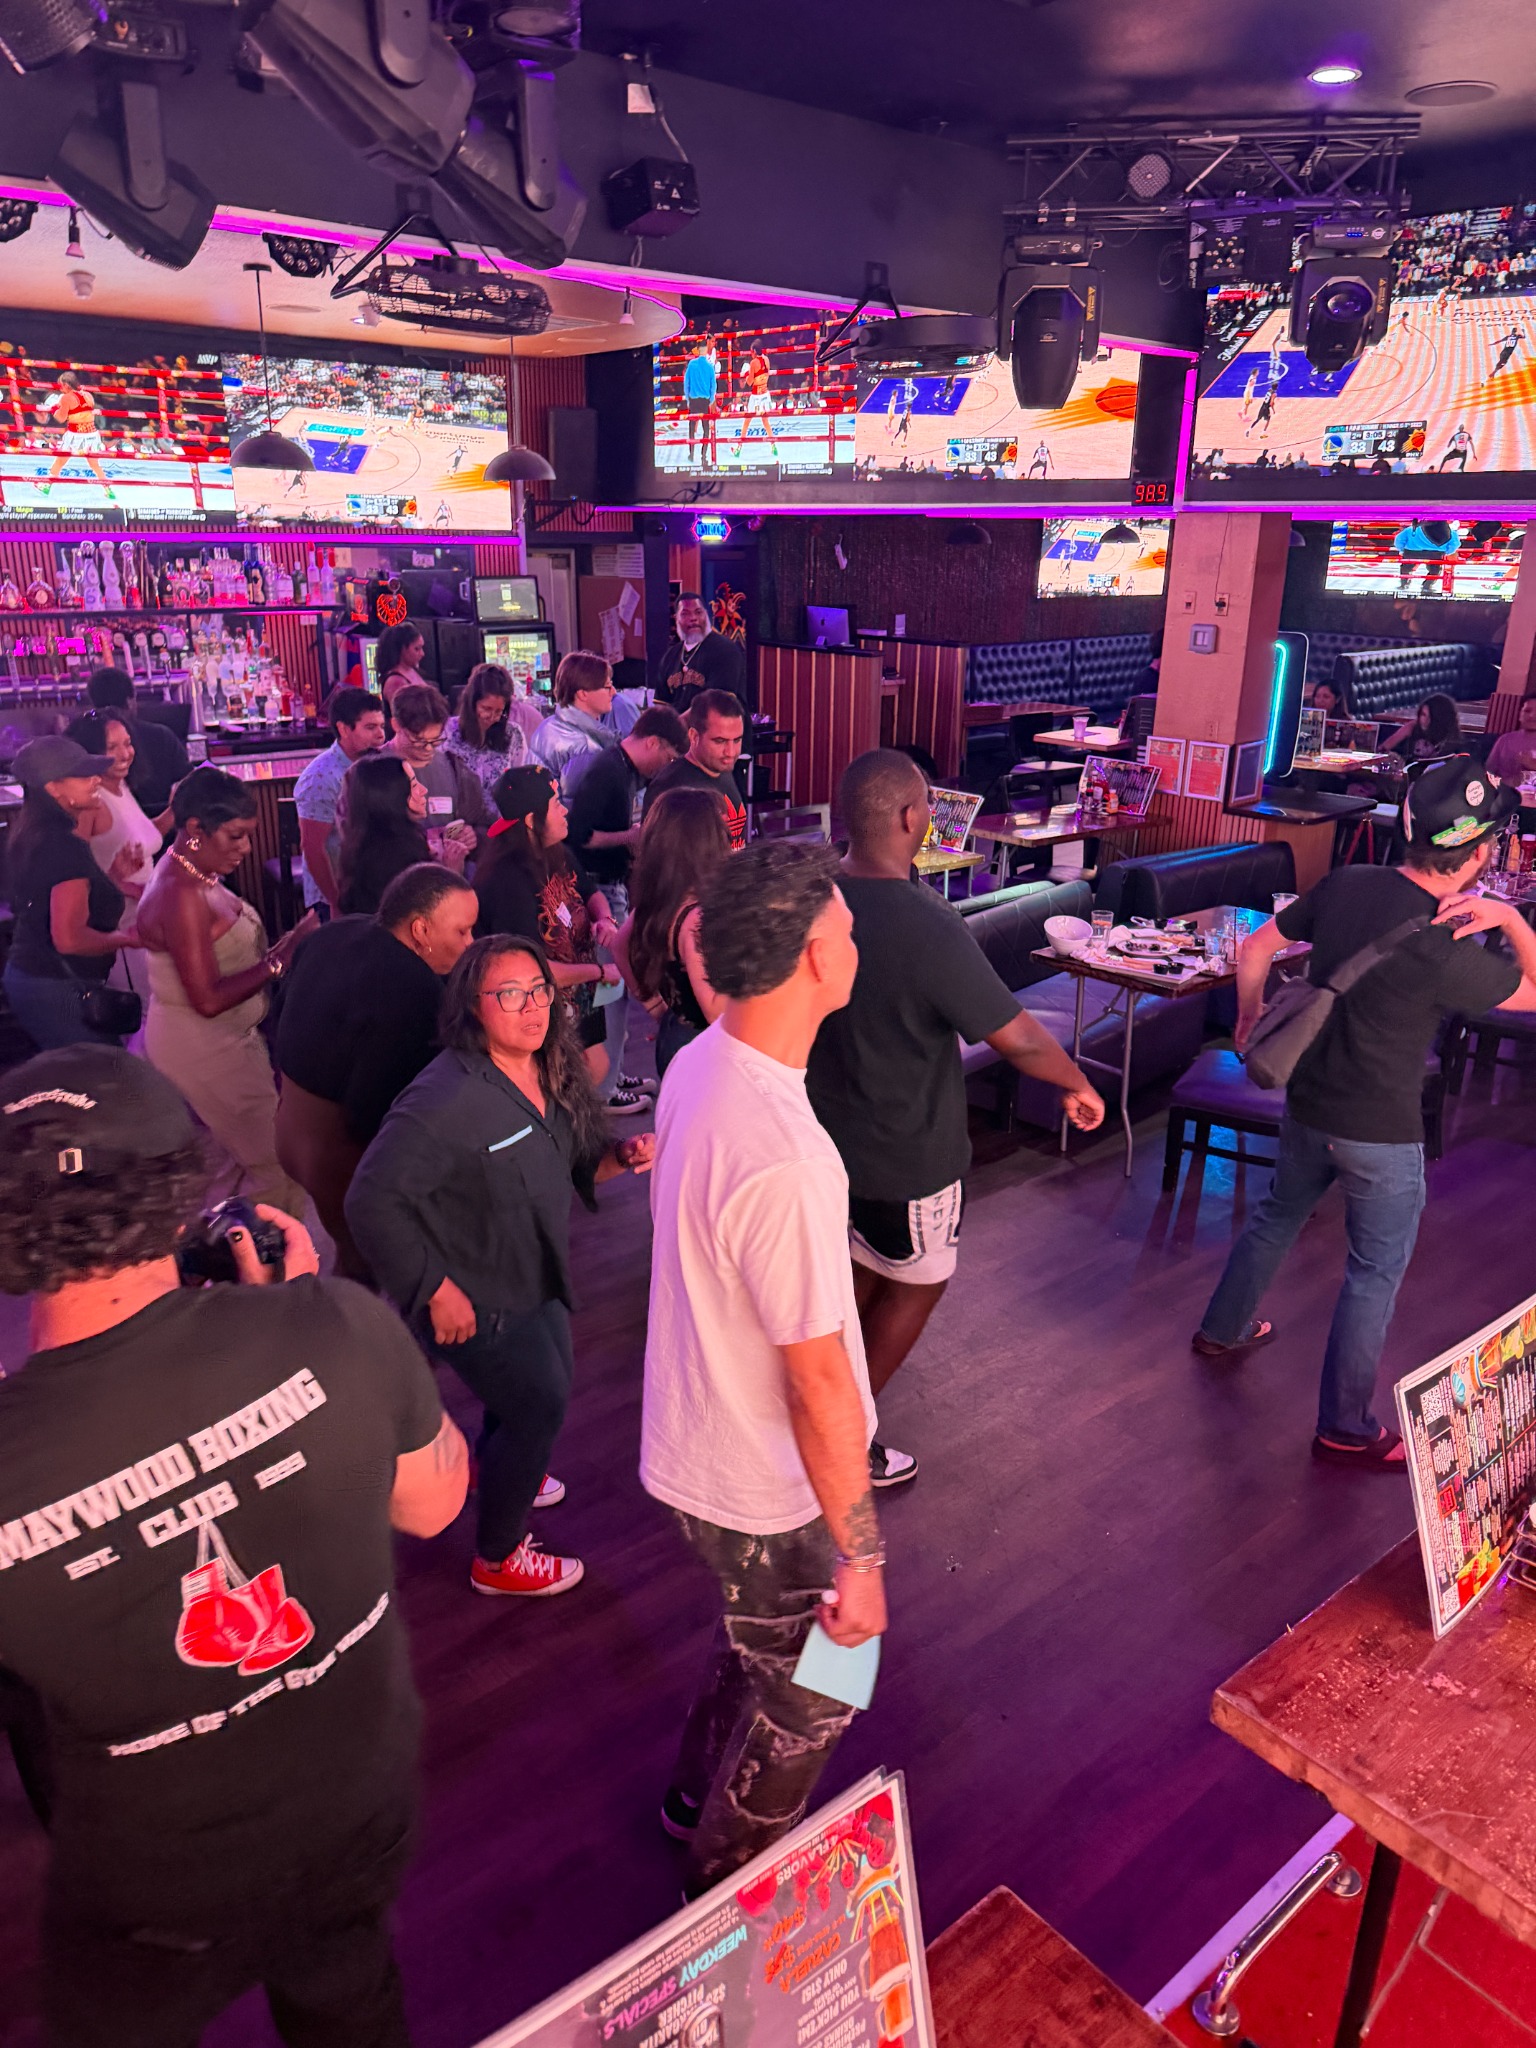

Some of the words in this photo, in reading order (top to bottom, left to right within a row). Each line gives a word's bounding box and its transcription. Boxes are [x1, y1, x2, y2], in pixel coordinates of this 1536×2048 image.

[964, 452, 977, 462] 33
[984, 451, 998, 462] 43
[1350, 441, 1367, 453] 33
[1377, 440, 1396, 452] 43
[0, 1443, 196, 1571] MAYWOOD
[187, 1367, 327, 1474] BOXING
[64, 1546, 121, 1580] EST.
[138, 1481, 239, 1548] CLUB
[190, 1710, 229, 1735] OF
[228, 1677, 286, 1716] THE
[775, 1839, 831, 1886] FLAVORS
[678, 1924, 748, 1988] WEEKDAY
[779, 1933, 841, 1995] CAZUELA
[823, 1958, 848, 1989] ONLY
[603, 1975, 677, 2041] SPECIALS
[657, 1984, 704, 2029] PITCHER
[801, 1977, 823, 2005] $15!
[840, 1985, 860, 2011] YOU
